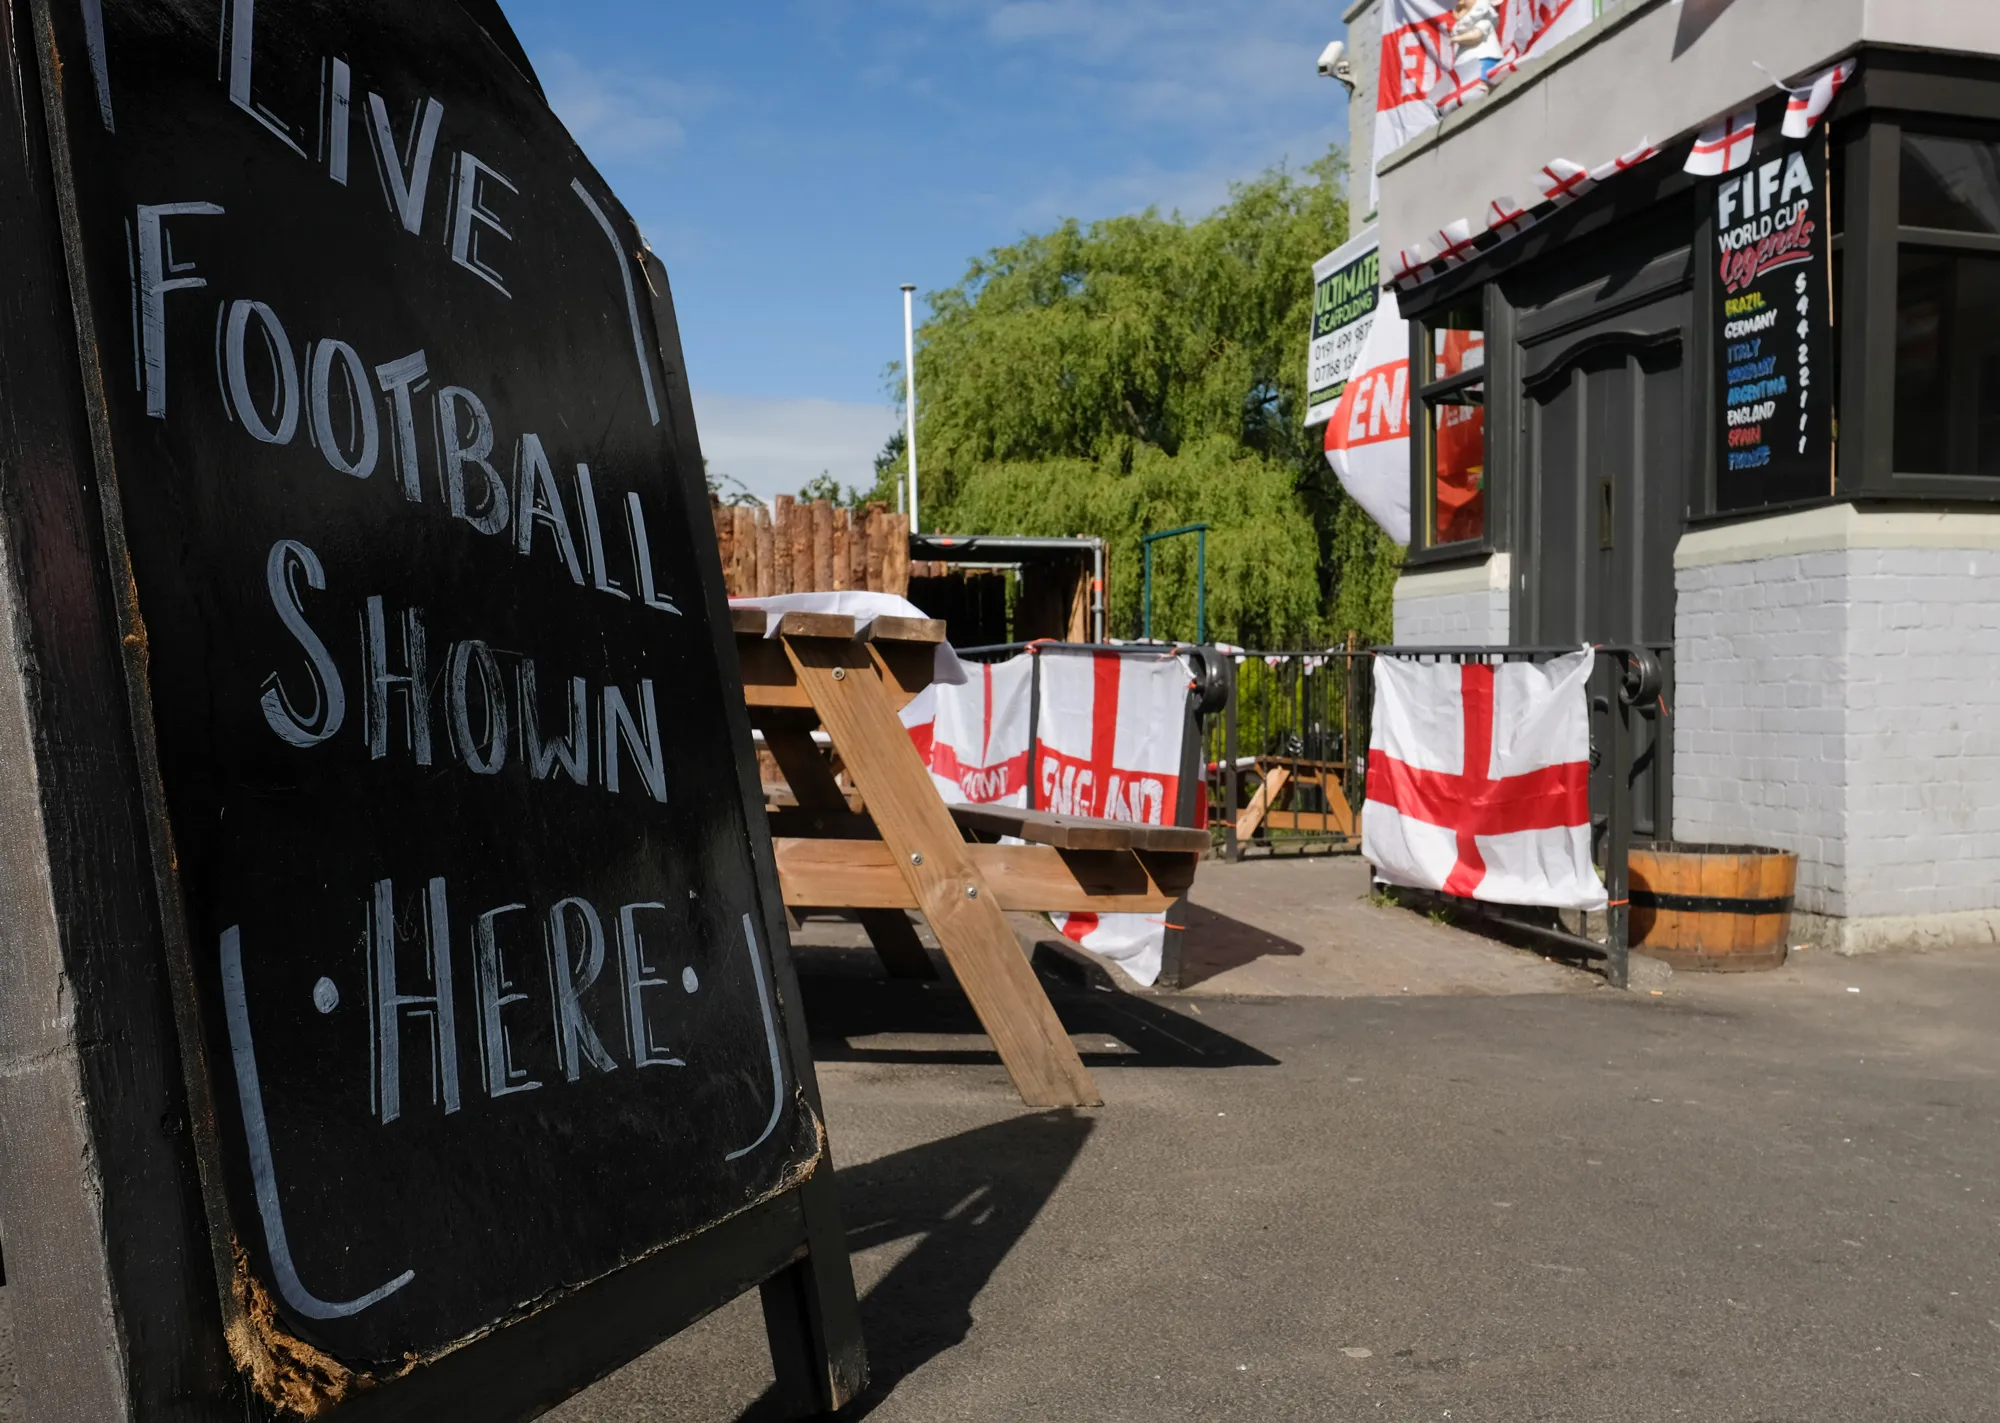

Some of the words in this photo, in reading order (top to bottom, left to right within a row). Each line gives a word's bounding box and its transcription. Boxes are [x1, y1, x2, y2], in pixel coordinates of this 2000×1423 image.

[218, 0, 518, 299] LIVE
[1718, 151, 1813, 229] FIFA
[1718, 216, 1772, 253] WORLD
[1774, 198, 1809, 229] CUP
[1316, 250, 1379, 316] ULTIMATE
[1725, 291, 1766, 318] BRAZIL
[1795, 271, 1807, 294] 5
[1319, 291, 1373, 334] SCAFFOLDING
[1724, 308, 1777, 339] GERMANY
[1727, 338, 1761, 364] ITALY
[1796, 318, 1809, 340] 4
[1798, 343, 1809, 365] 2
[124, 201, 682, 616] FOOTBALL
[1727, 376, 1787, 406] ARGENTINA
[1799, 366, 1810, 387] 2
[1727, 401, 1776, 426] ENGLAND
[1800, 389, 1808, 409] 1
[1728, 425, 1761, 448] SPAIN
[1799, 413, 1808, 432] 1
[1798, 435, 1807, 454] 1
[261, 539, 667, 803] SHOWN
[366, 876, 686, 1126] HERE
